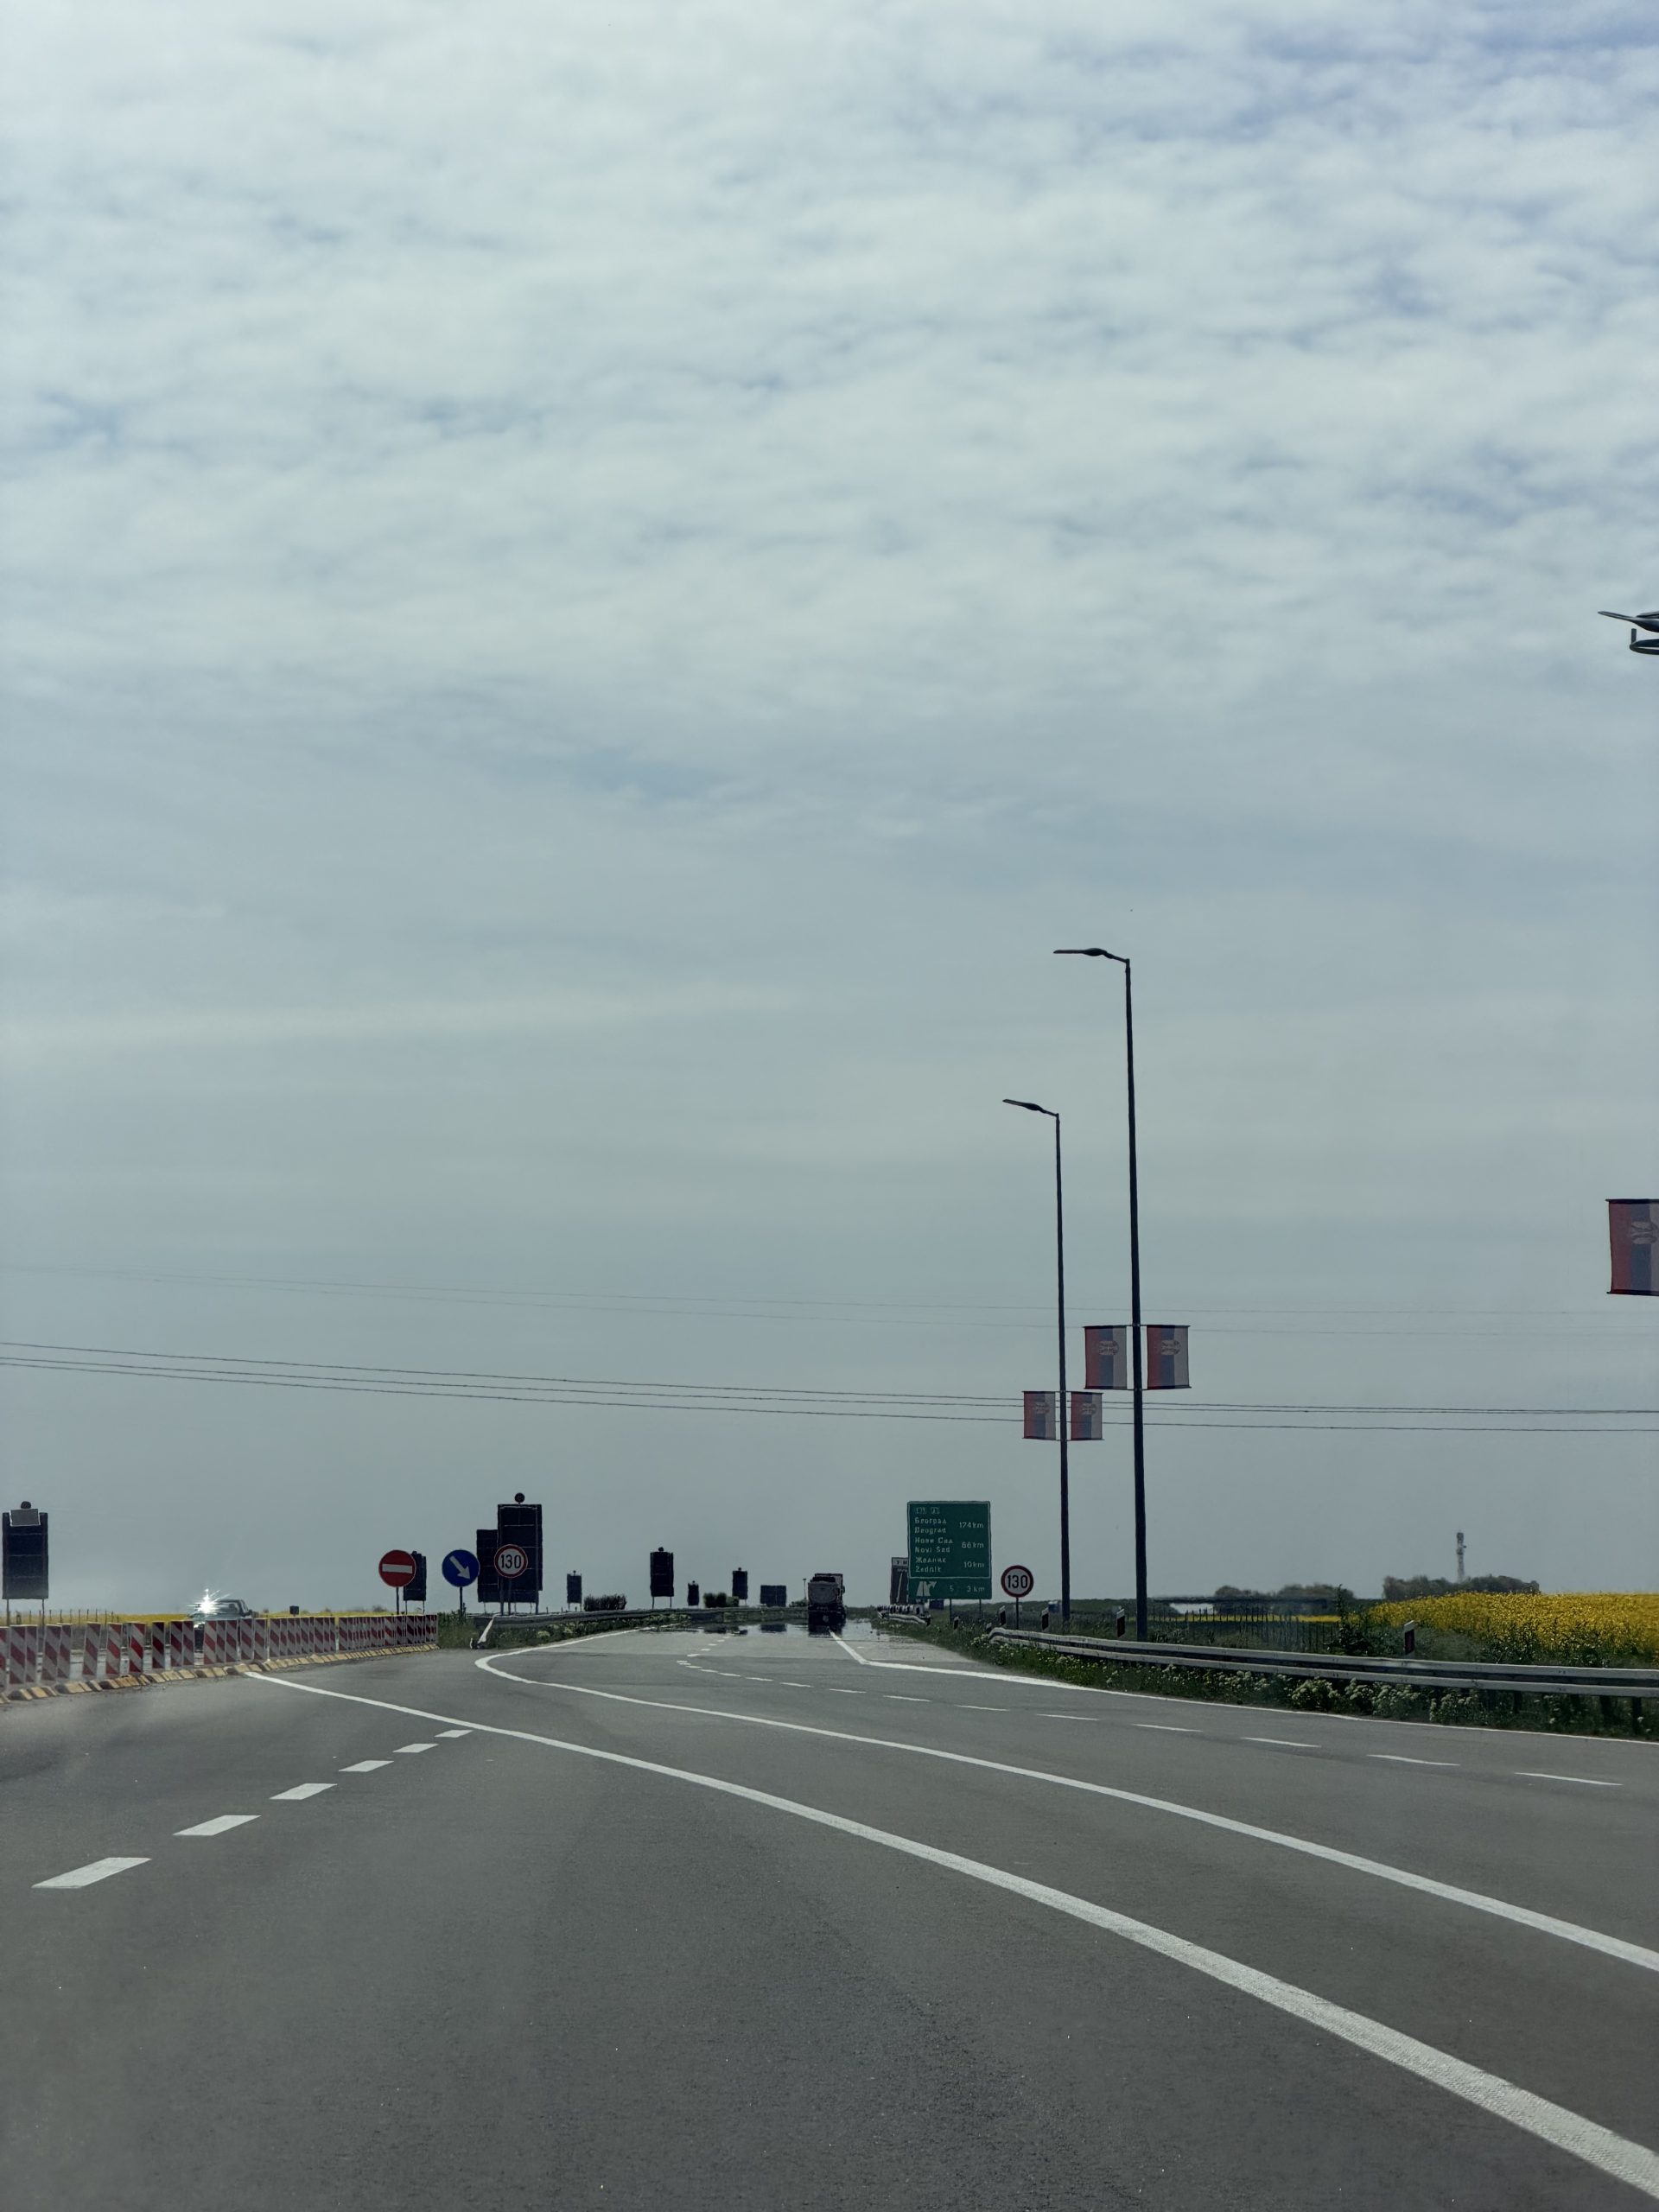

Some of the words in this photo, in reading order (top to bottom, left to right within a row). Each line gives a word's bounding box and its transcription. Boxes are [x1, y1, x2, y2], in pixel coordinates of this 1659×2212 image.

[914, 1516, 947, 1525] Београд
[914, 1526, 947, 1535] Beograd
[500, 1554, 521, 1569] 130
[1007, 1574, 1028, 1589] 130
